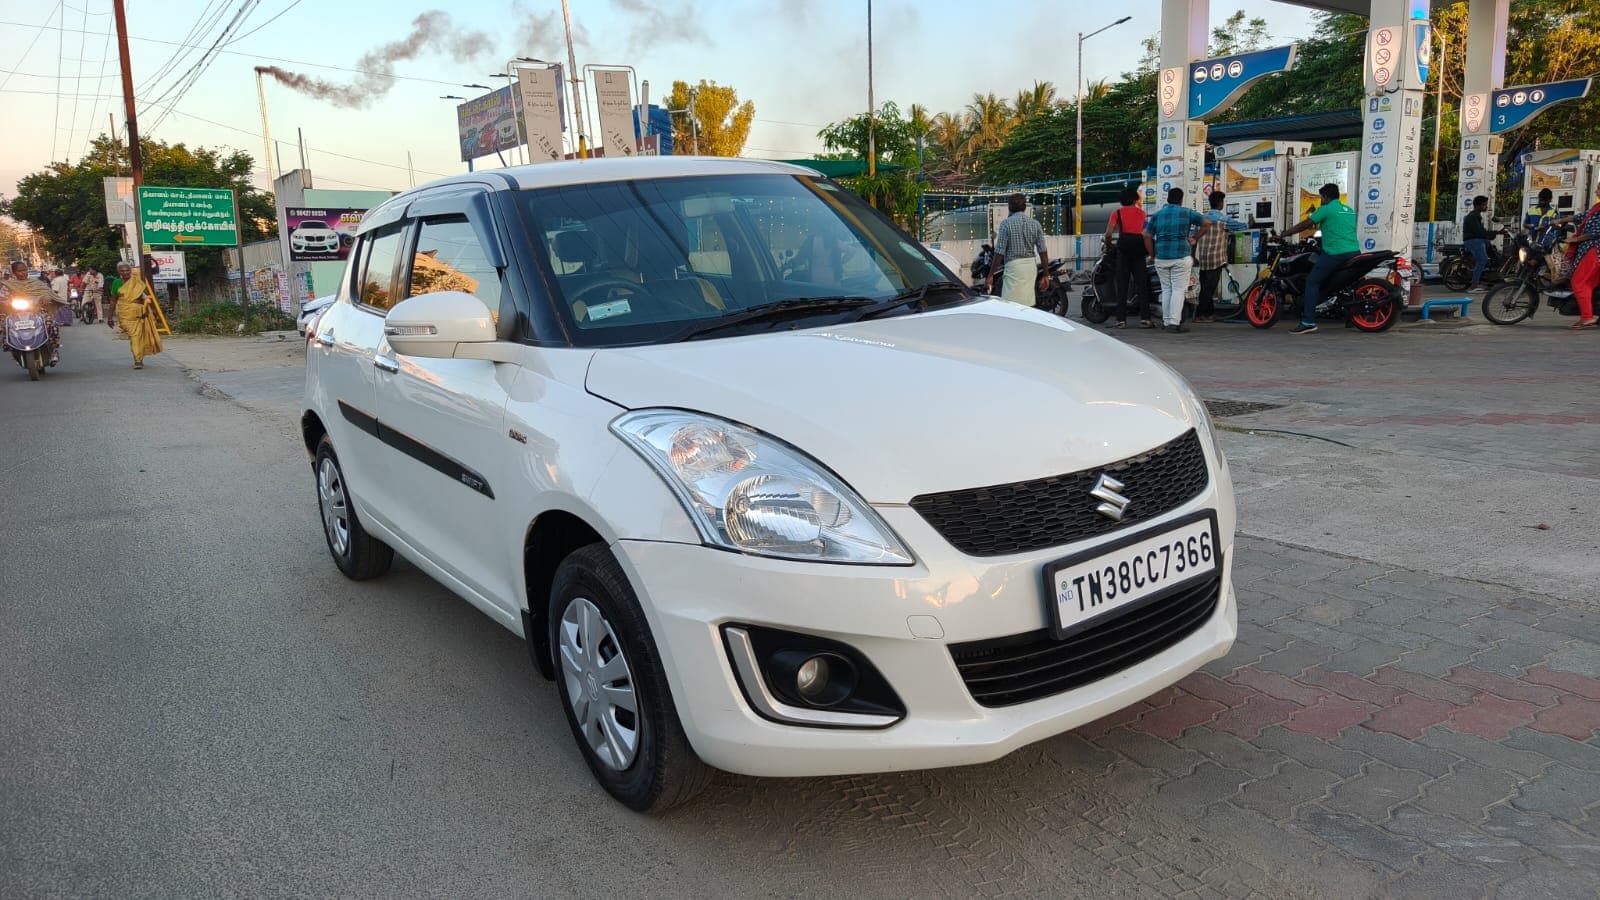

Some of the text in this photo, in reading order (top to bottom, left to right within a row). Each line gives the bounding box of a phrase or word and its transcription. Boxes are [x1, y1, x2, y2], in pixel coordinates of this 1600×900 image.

[1196, 93, 1202, 106] 1
[1498, 115, 1505, 125] 3
[1072, 531, 1212, 612] TN38CC7366
[1059, 590, 1073, 604] IND
